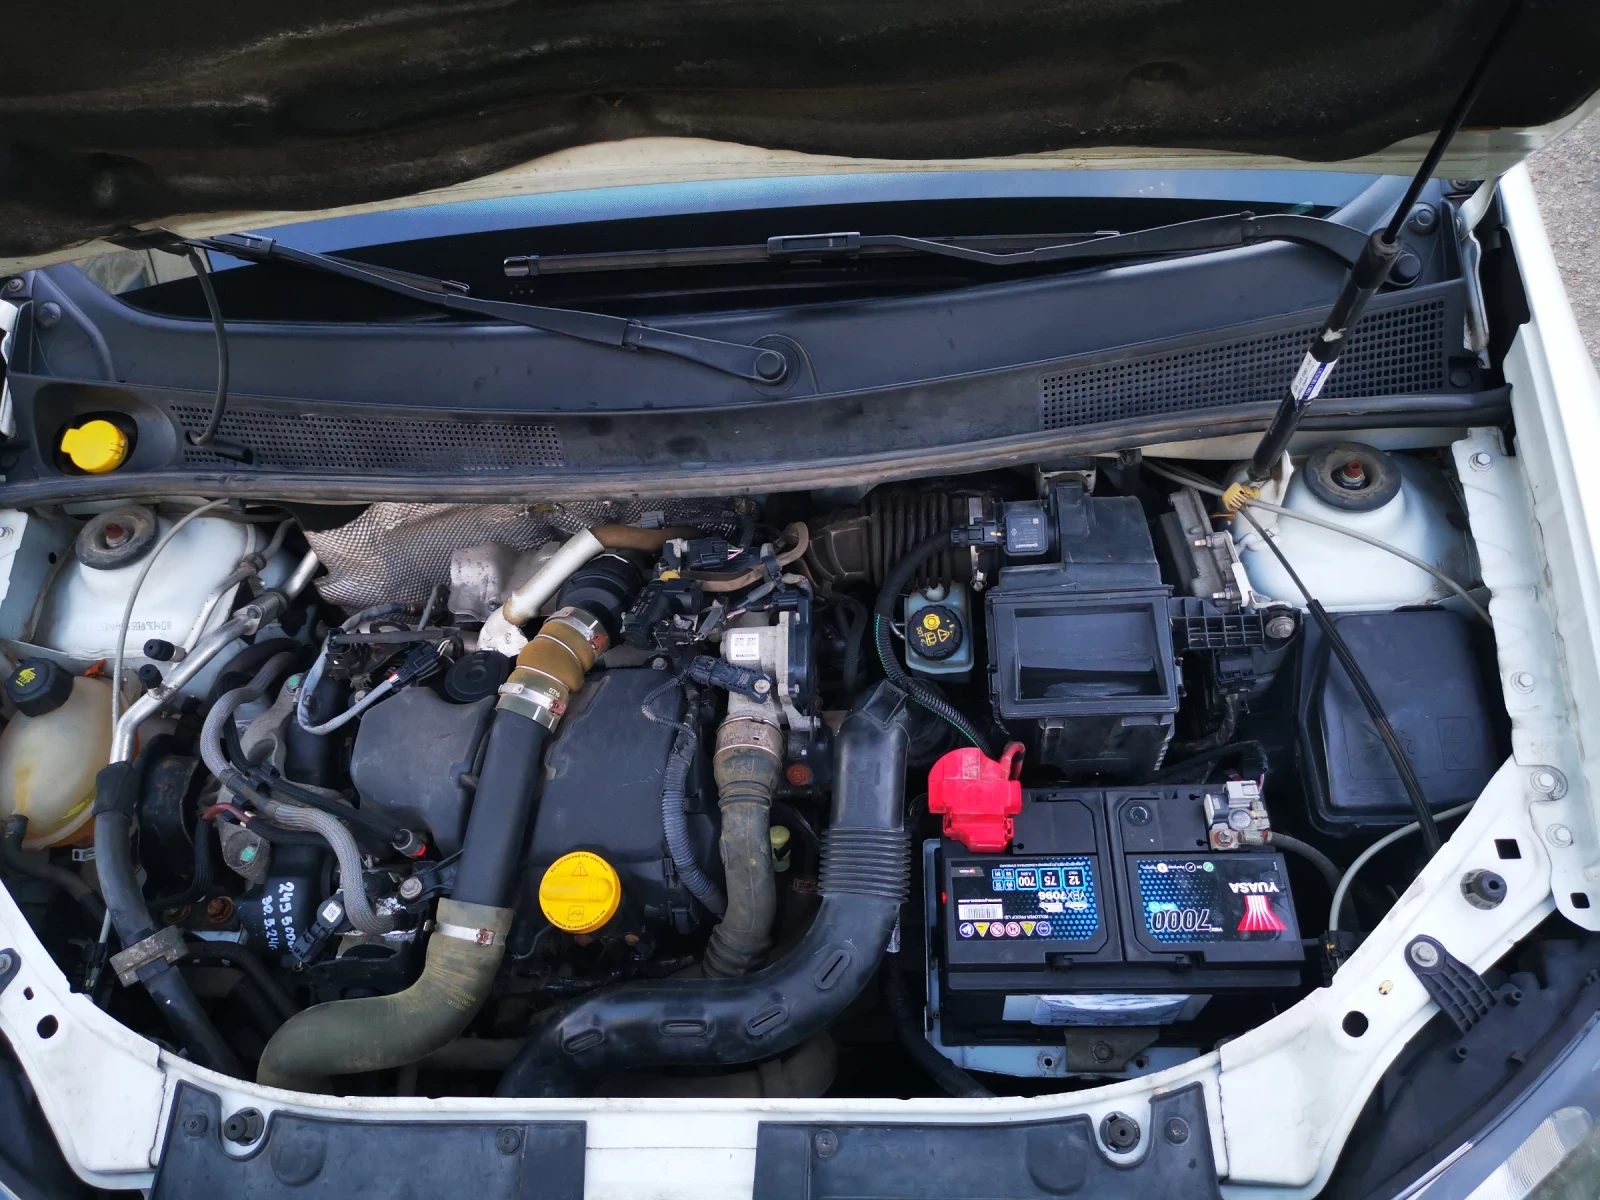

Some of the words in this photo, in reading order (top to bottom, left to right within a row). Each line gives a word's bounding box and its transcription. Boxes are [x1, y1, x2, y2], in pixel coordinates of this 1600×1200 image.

[563, 854, 580, 862] exceed
[1018, 876, 1036, 886] 700
[1044, 876, 1057, 886] 75
[1069, 876, 1080, 885] 12
[1229, 882, 1279, 893] YUASA
[279, 882, 294, 913] 245
[1038, 891, 1087, 900] YBX7096
[1151, 909, 1211, 932] 7000
